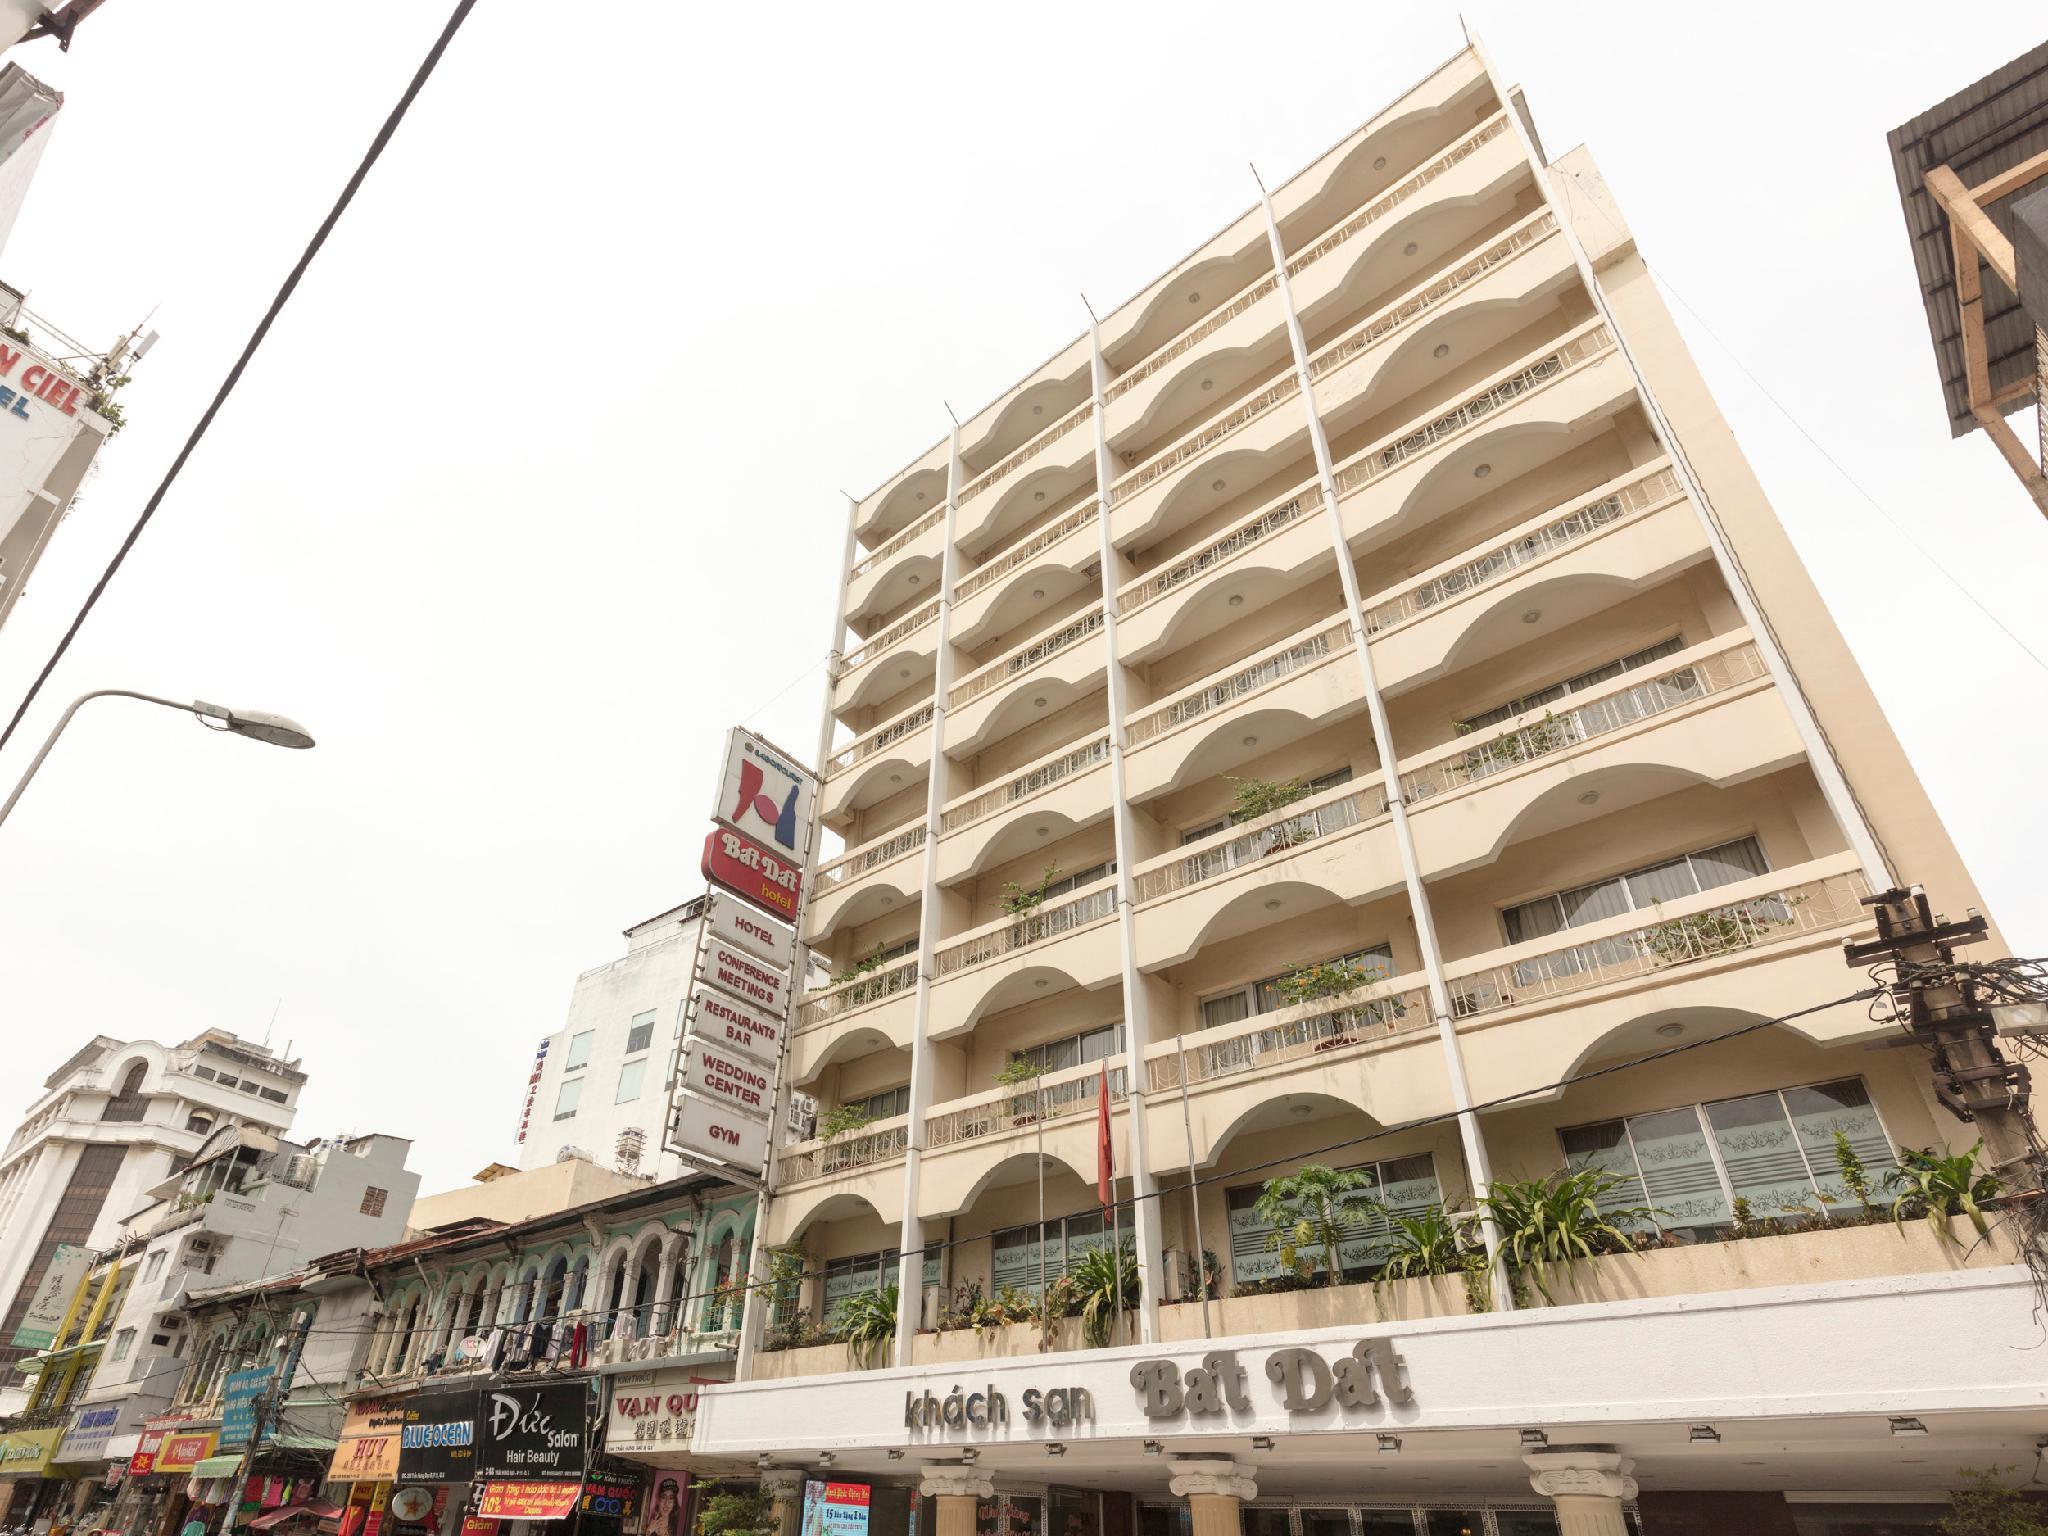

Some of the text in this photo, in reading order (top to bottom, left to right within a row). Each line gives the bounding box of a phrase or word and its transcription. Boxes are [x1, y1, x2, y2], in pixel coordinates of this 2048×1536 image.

[21, 365, 81, 418] CIEL
[761, 883, 792, 909] hotel
[735, 916, 775, 946] HOTEL
[718, 950, 780, 990] CONFERENCE
[717, 967, 775, 1004] MEETINGS
[705, 999, 776, 1040] RESTAURANTS
[726, 1024, 751, 1046] BAR
[702, 1052, 767, 1090] WEDDING
[704, 1073, 761, 1106] CENTER
[709, 1124, 740, 1147] GYM
[353, 1438, 388, 1457] HUY
[402, 1420, 474, 1448] BLUE OCEAN
[547, 1430, 578, 1448] Salon
[506, 1449, 560, 1466] Hair Beauty
[483, 1496, 501, 1512] 10%
